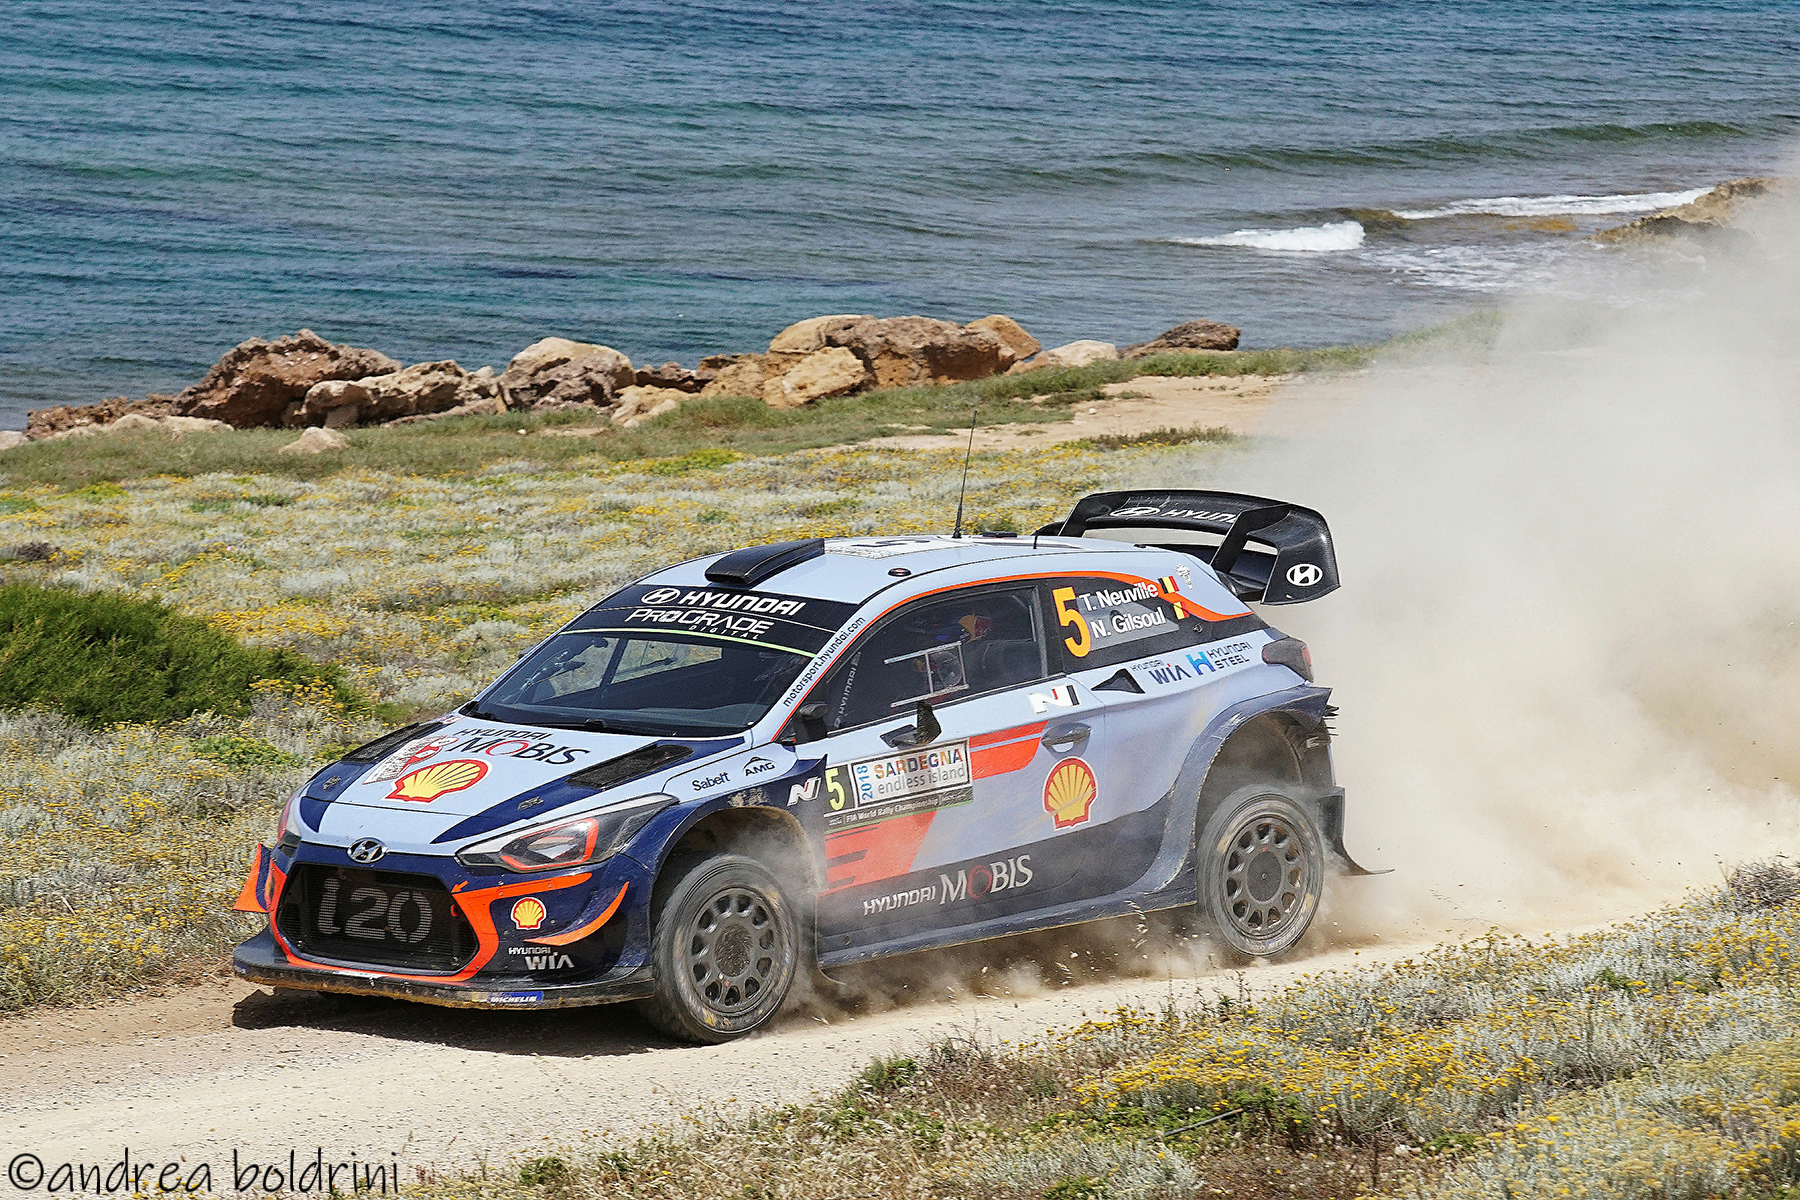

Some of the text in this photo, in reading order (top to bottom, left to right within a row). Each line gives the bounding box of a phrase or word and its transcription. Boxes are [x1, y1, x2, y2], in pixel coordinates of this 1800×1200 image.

[678, 590, 807, 616] HYUNDAI
[1078, 581, 1160, 612] T. Neuville
[624, 608, 775, 635] PROGRADE
[688, 625, 761, 640] DIGITAL
[1052, 586, 1092, 658] 5
[1091, 606, 1167, 639] N. Gilsoul
[783, 616, 866, 708] motorsport.hyundai.com
[1206, 641, 1253, 659] HYUNDAI
[1214, 654, 1250, 670] STEEL
[453, 728, 553, 741] HYUNDAI
[446, 738, 590, 765] MOBIS
[874, 749, 964, 779] SARDEGNA
[692, 772, 730, 791] Sabelt
[825, 767, 845, 811] 5
[856, 765, 873, 800] 2018
[877, 763, 966, 794] endless island
[862, 854, 1034, 916] HYUNDAI MOBIS
[508, 946, 551, 956] HYUNDAI
[490, 995, 537, 1003] MICHELIN
